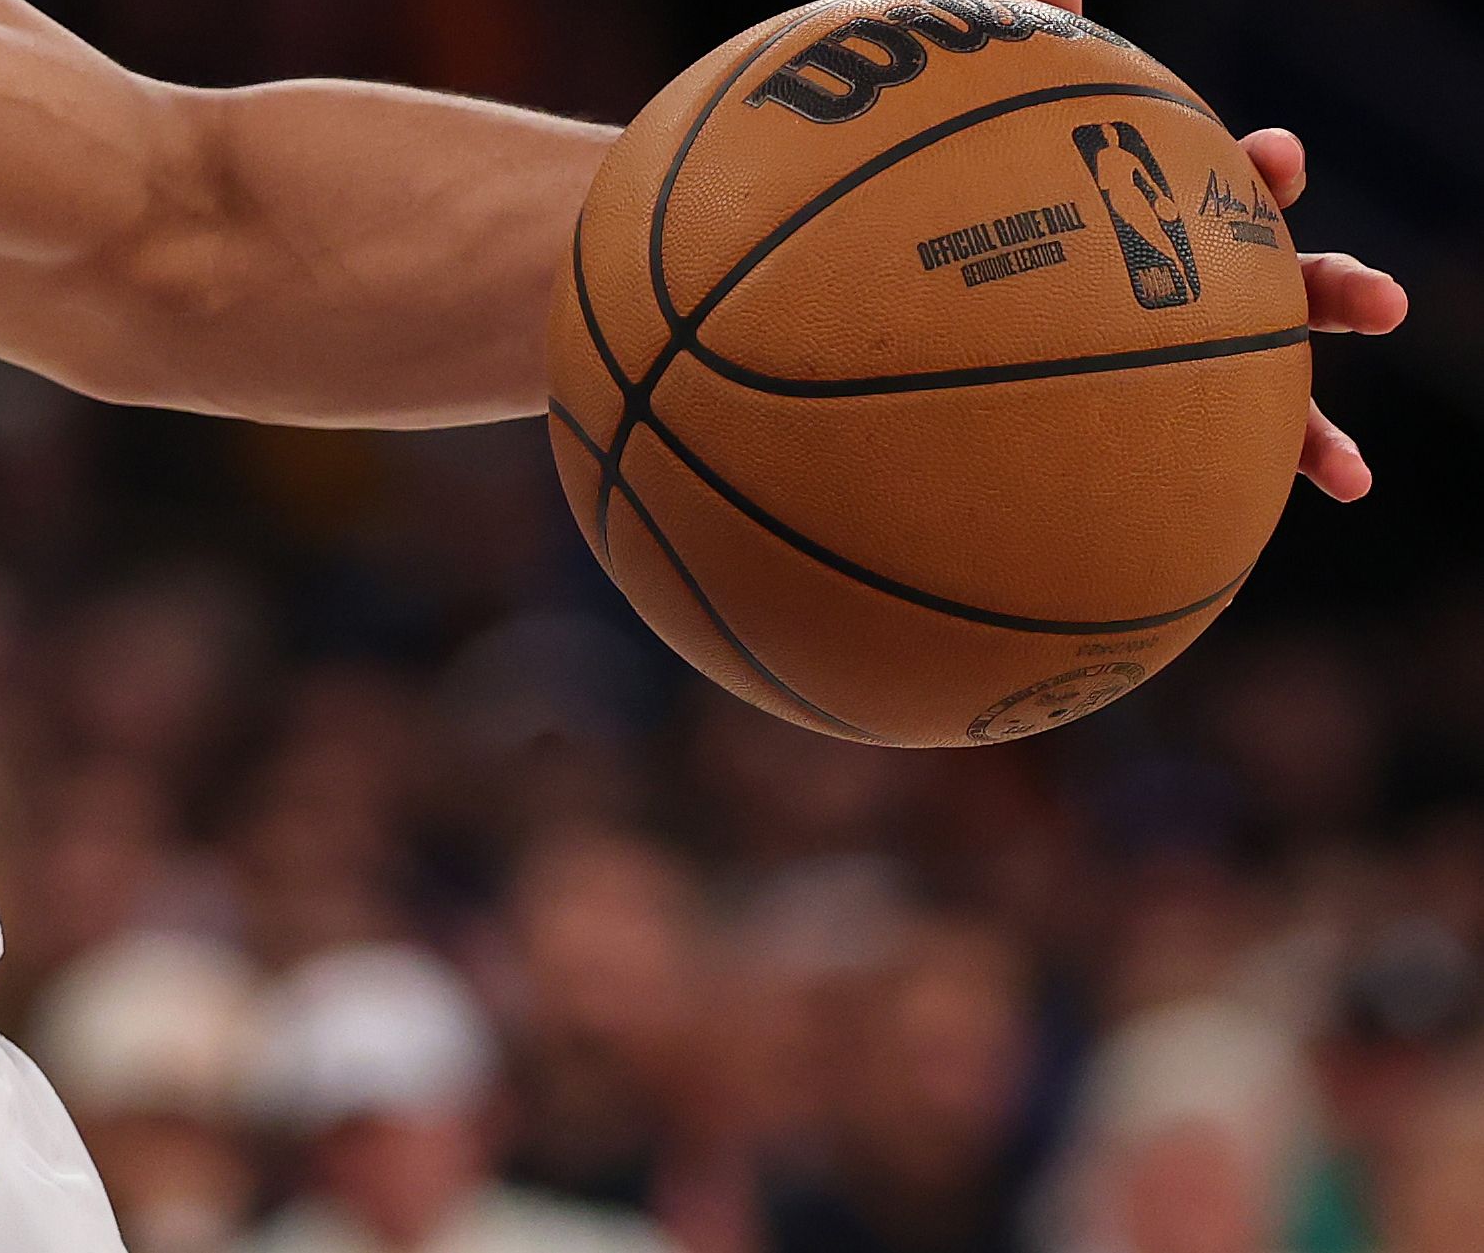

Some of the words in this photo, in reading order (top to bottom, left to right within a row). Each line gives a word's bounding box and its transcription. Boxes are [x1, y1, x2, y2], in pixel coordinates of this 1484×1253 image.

[917, 223, 997, 271] OFFICIAL
[993, 210, 1045, 247] GAME
[1042, 202, 1086, 235] BALL
[960, 251, 1017, 288] GENUINE
[1014, 240, 1067, 274] LEATHER
